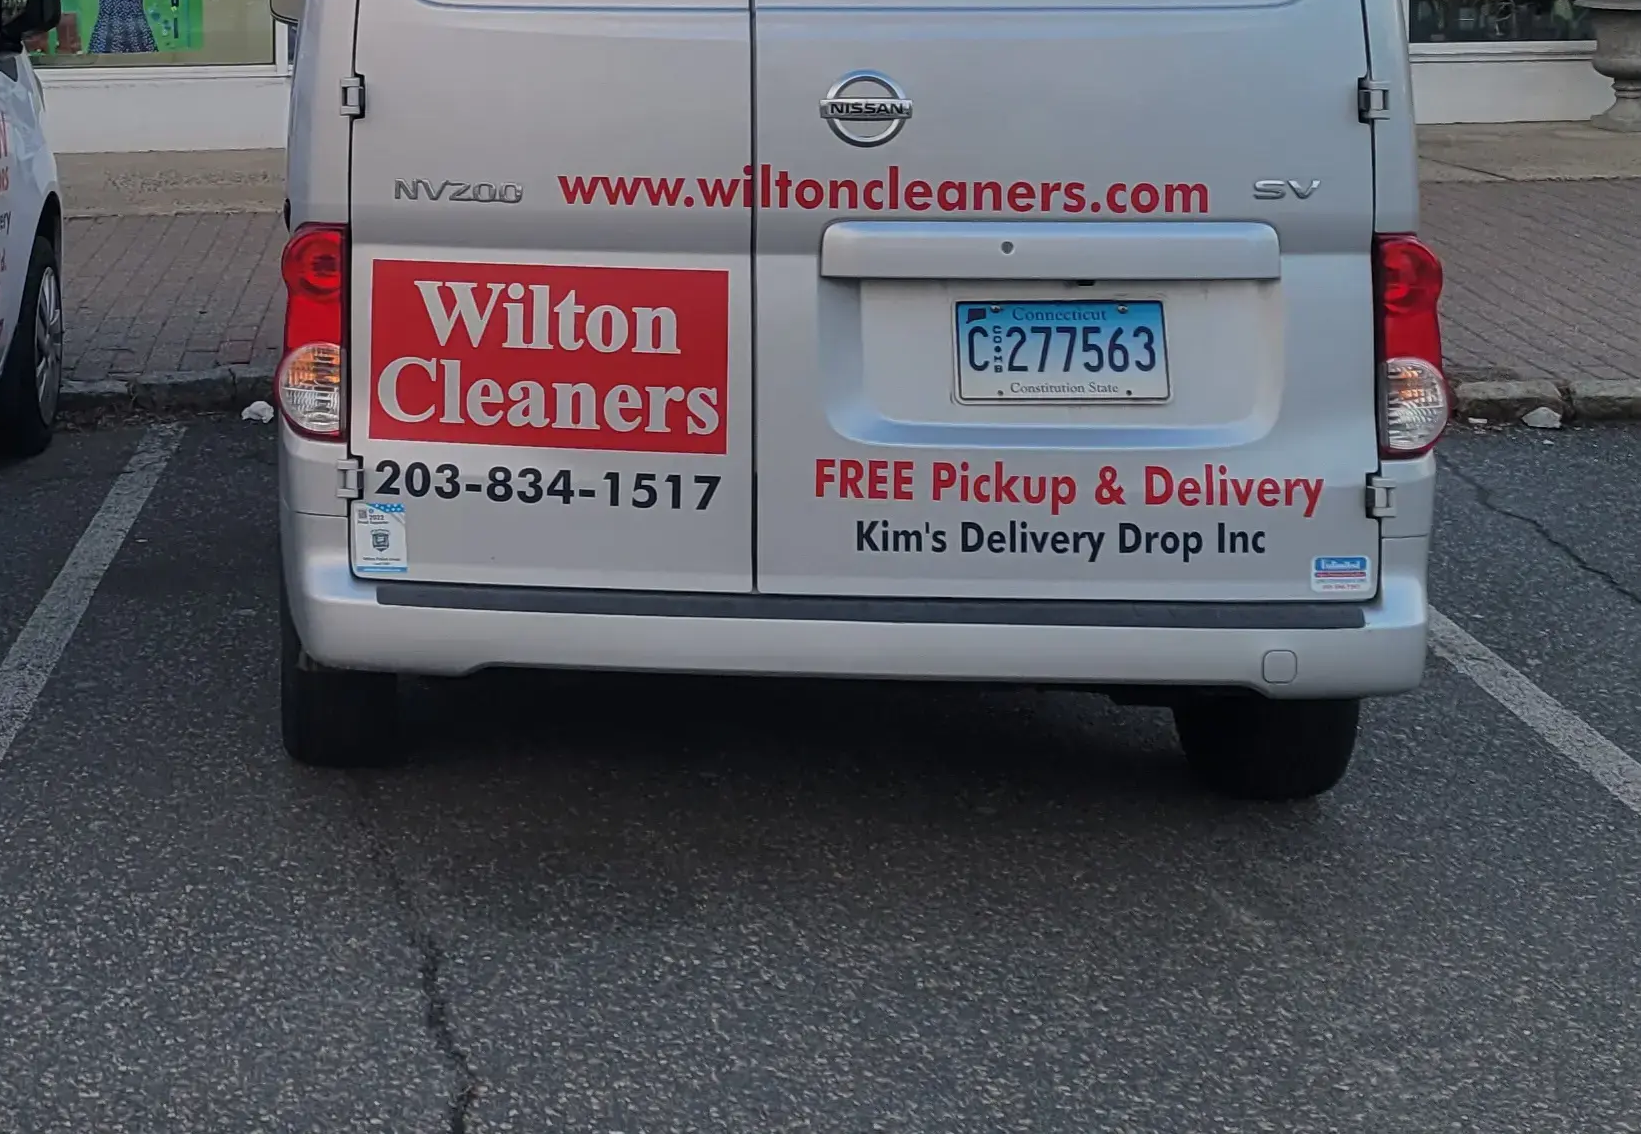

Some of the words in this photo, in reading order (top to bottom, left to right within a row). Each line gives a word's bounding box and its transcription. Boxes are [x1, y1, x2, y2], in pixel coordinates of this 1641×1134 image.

[830, 103, 903, 115] NISSAN
[394, 178, 524, 204] NV200
[1252, 177, 1321, 200] SV
[557, 163, 1209, 214] www.wiltoncleaners.com
[414, 279, 681, 354] Wilton
[1012, 307, 1107, 322] Connecticut
[377, 356, 720, 436] Cleaners
[1010, 382, 1086, 394] Constitution
[1089, 382, 1119, 394] State
[375, 459, 721, 511] 203-834-1517
[814, 458, 913, 500] FREE
[931, 459, 1077, 515] Pickup
[1094, 465, 1126, 505] &
[1143, 463, 1324, 517] Delivery
[856, 521, 947, 554] Kim's
[960, 521, 1106, 563] Delivery
[1118, 522, 1204, 563] Drop
[1217, 523, 1266, 554] Inc
